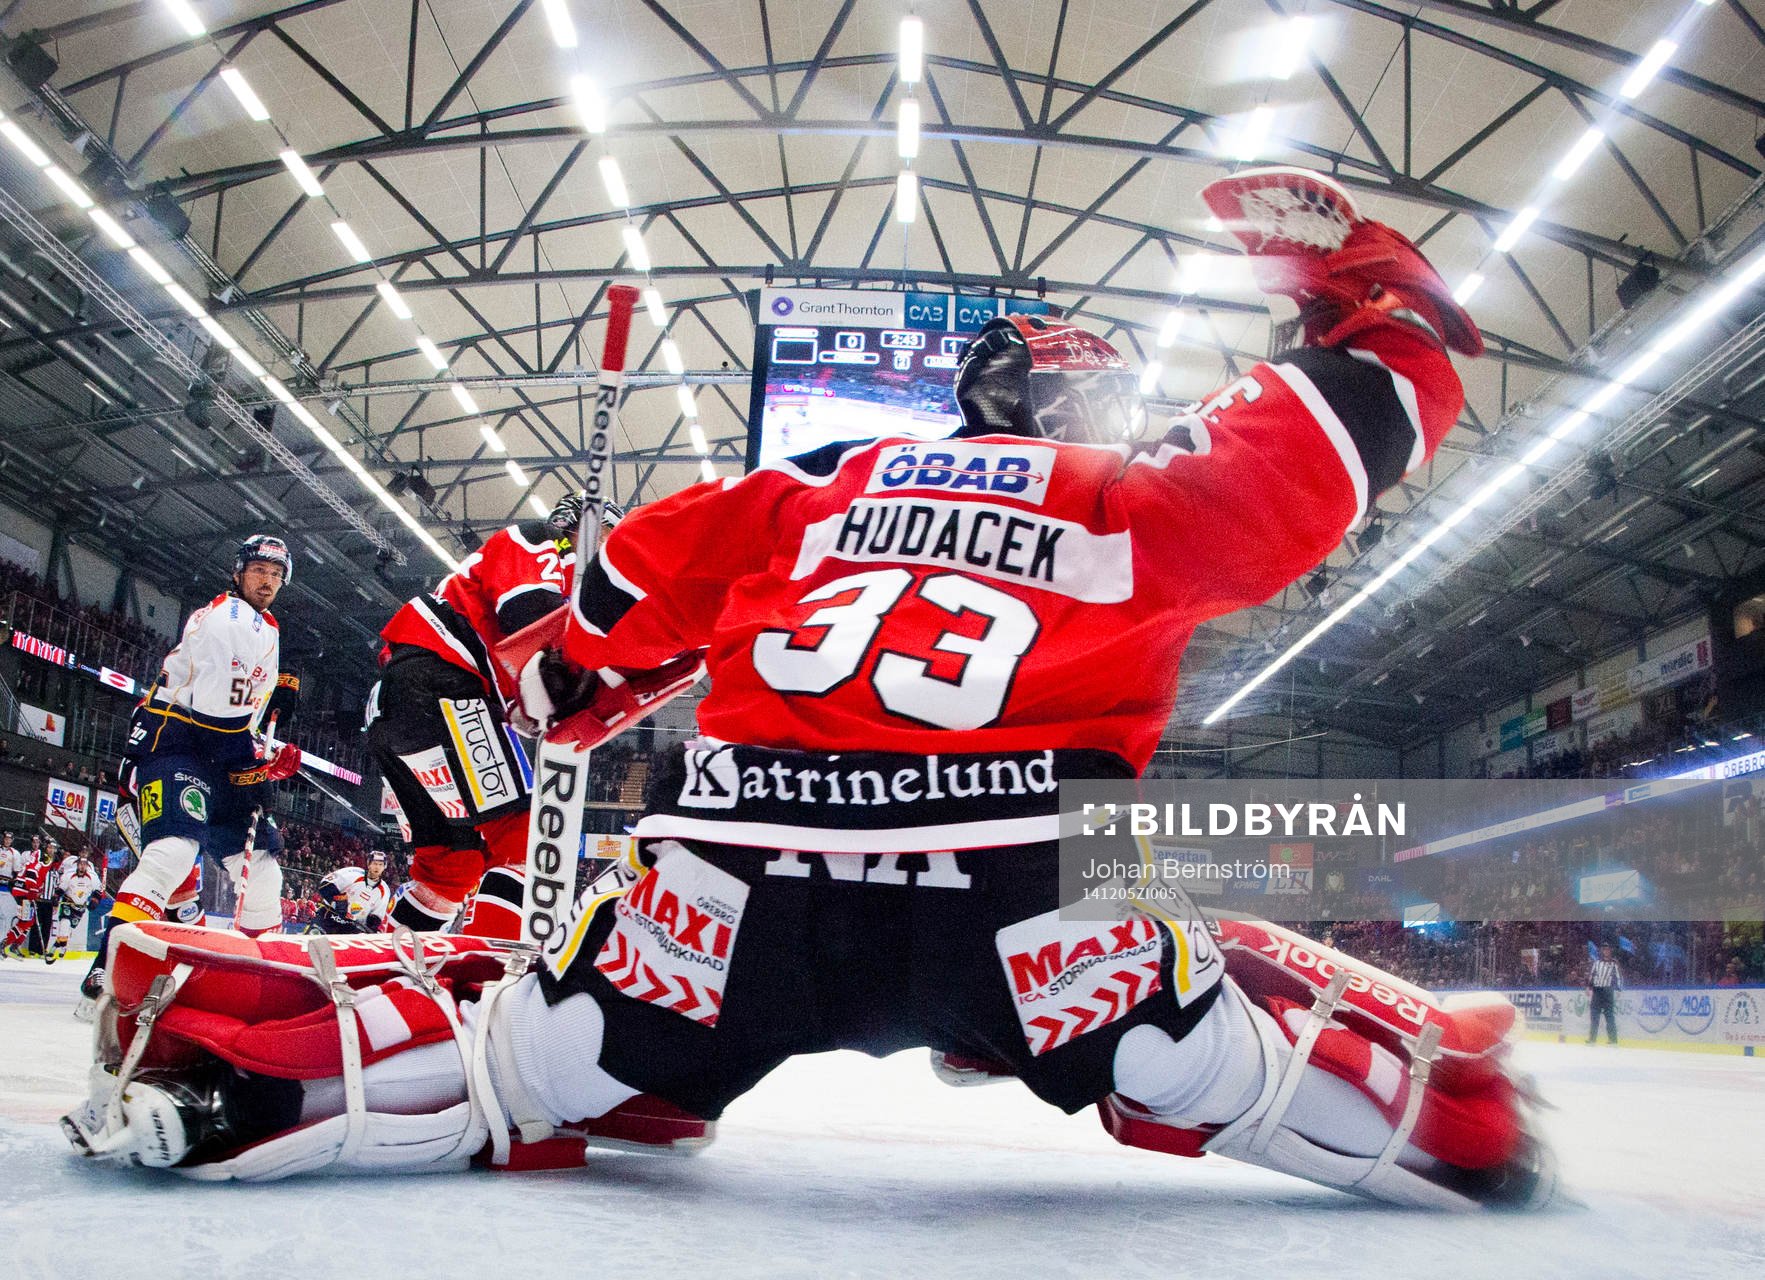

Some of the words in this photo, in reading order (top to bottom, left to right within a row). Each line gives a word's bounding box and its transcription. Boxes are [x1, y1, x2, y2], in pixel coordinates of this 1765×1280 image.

[800, 301, 836, 314] Grant
[838, 302, 894, 316] Thornton
[909, 305, 944, 321] CAB
[581, 384, 618, 514] Reebok
[880, 446, 1032, 493] ÖBAB
[836, 505, 1066, 583] HUDACEK
[752, 568, 1041, 731] 33
[230, 678, 253, 706] 52
[51, 788, 86, 810] ELON
[686, 748, 1059, 806] Katrinelund
[528, 758, 577, 944] Reebo
[1233, 881, 1261, 890] KPMG
[1368, 874, 1392, 882] DAHL
[624, 867, 732, 959] MAXI
[1007, 913, 1156, 994] MAXI
